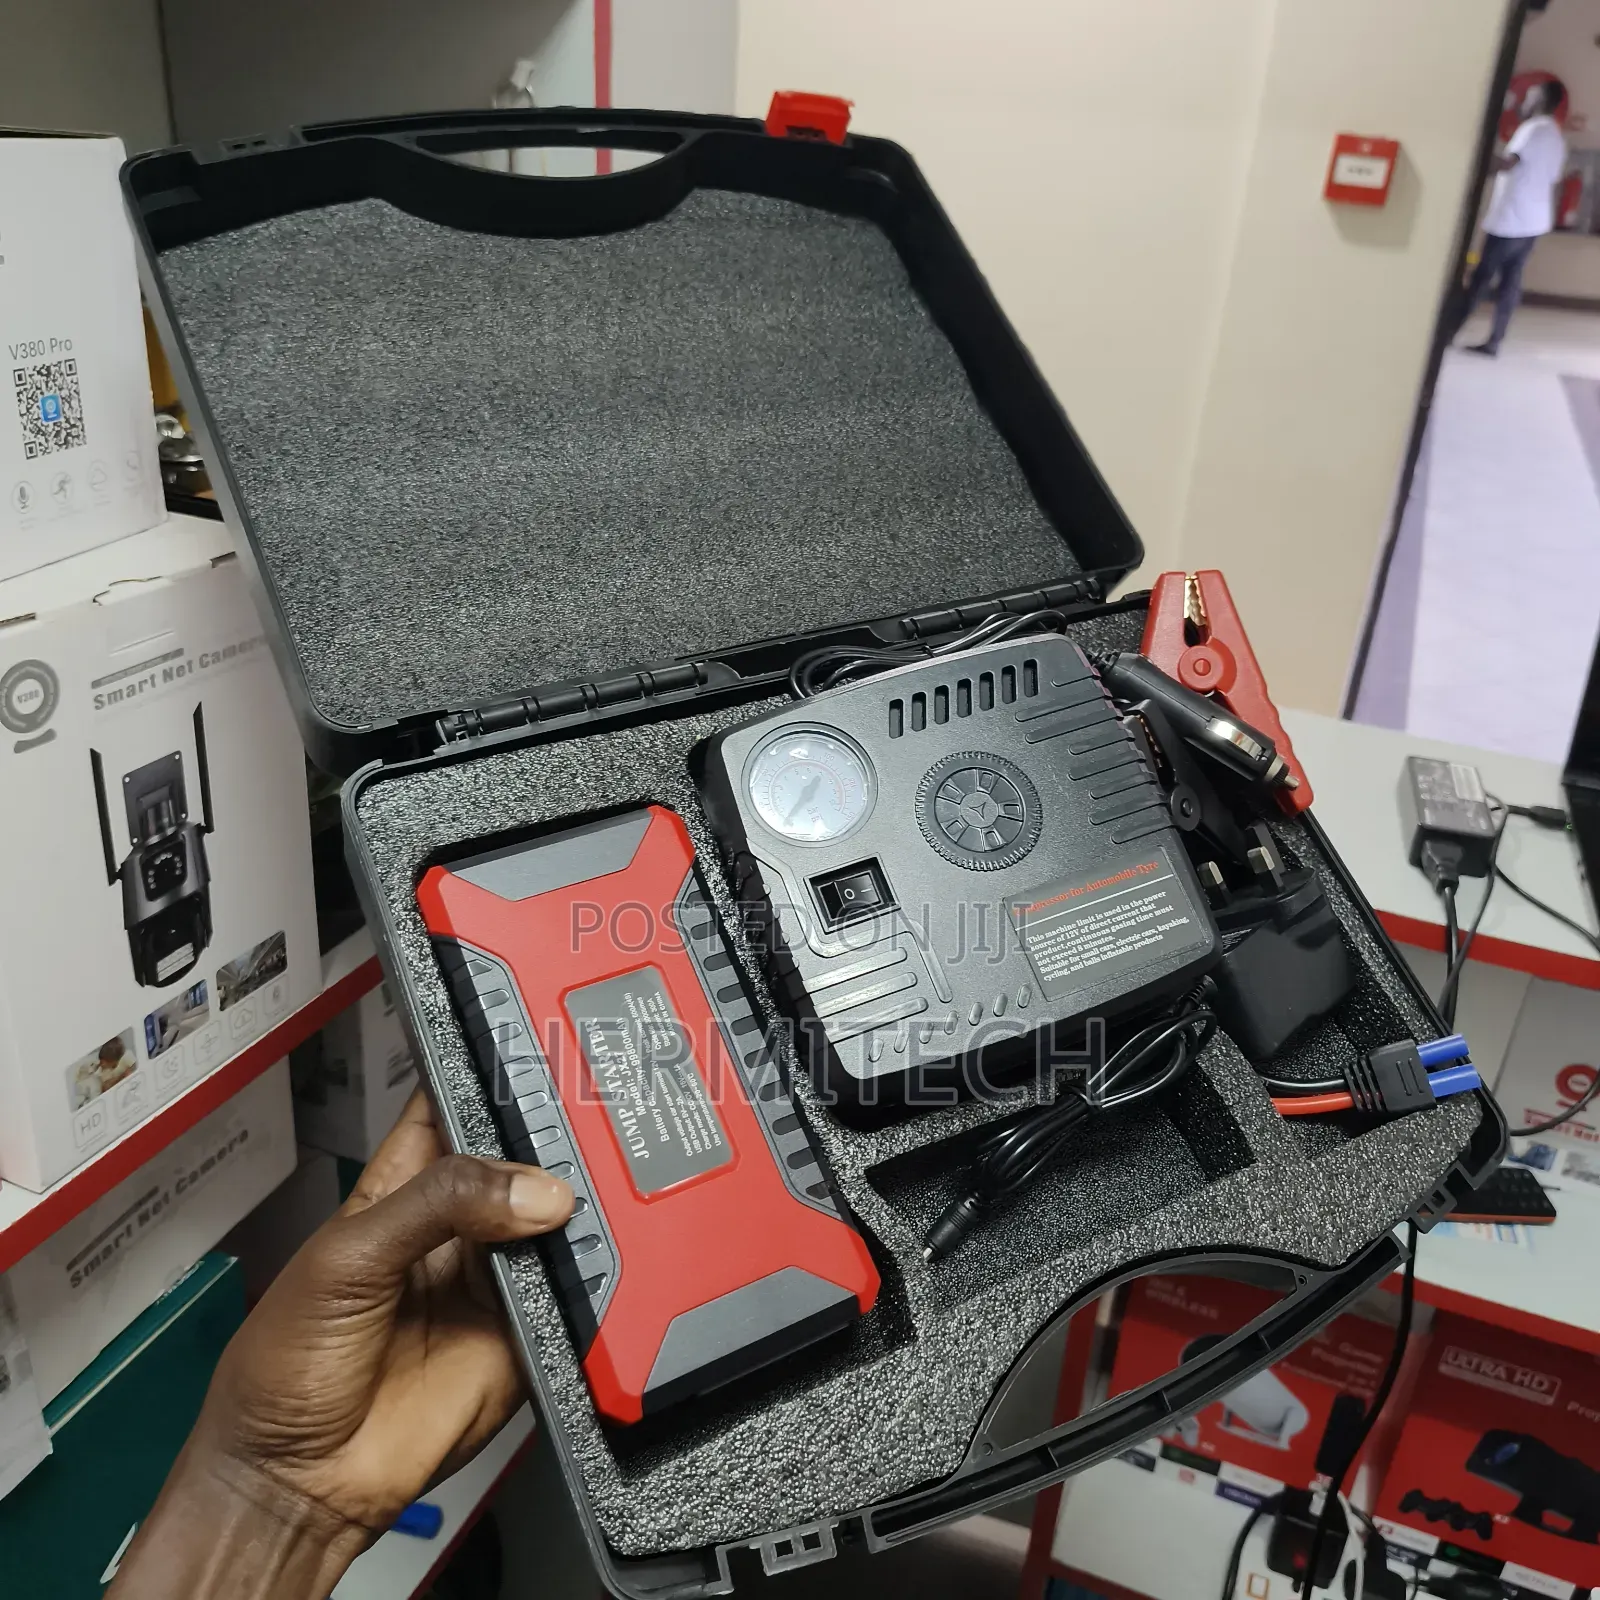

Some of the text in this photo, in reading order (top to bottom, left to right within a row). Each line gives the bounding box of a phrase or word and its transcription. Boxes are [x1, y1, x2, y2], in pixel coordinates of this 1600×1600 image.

[8, 337, 73, 361] V380 Pro
[93, 673, 157, 711] Smart
[163, 659, 194, 683] Net
[1068, 884, 1085, 897] for
[1083, 866, 1138, 892] Automobile
[1135, 859, 1160, 875] Tyre
[1026, 932, 1045, 944] This
[1043, 921, 1077, 939] machine
[1094, 912, 1104, 920] is
[1102, 905, 1122, 917] used
[1120, 902, 1130, 911] in
[1128, 898, 1143, 908] the
[1142, 890, 1168, 904] power
[1055, 933, 1066, 942] of
[1064, 928, 1080, 939] 12V
[1079, 925, 1089, 934] of
[1088, 917, 1112, 931] direct
[1110, 907, 1140, 923] current
[1138, 901, 1156, 912] that
[1109, 918, 1136, 932] gasing
[1135, 911, 1154, 922] time
[1153, 904, 1174, 916] must
[1036, 957, 1051, 967] not
[1050, 947, 1077, 961] exceed
[1082, 933, 1115, 950] minutes.
[1039, 958, 1069, 974] Suitable
[1068, 954, 1081, 963] for
[1079, 947, 1100, 959] small
[1114, 932, 1141, 947] electric
[1043, 966, 1071, 982] cycling,
[1069, 961, 1084, 972] and
[1083, 955, 1101, 967] balls
[1132, 932, 1164, 950] products
[653, 991, 666, 1011] CHINA
[664, 1017, 676, 1036] MADE
[583, 1016, 651, 1162] JUMP STARTER
[613, 1016, 672, 1142] Battery capacity: 99800mAh
[624, 1077, 647, 1116] Model:
[80, 1112, 101, 1135] HD
[691, 1138, 703, 1153] USB
[1447, 1351, 1550, 1391] ULTRA HD
